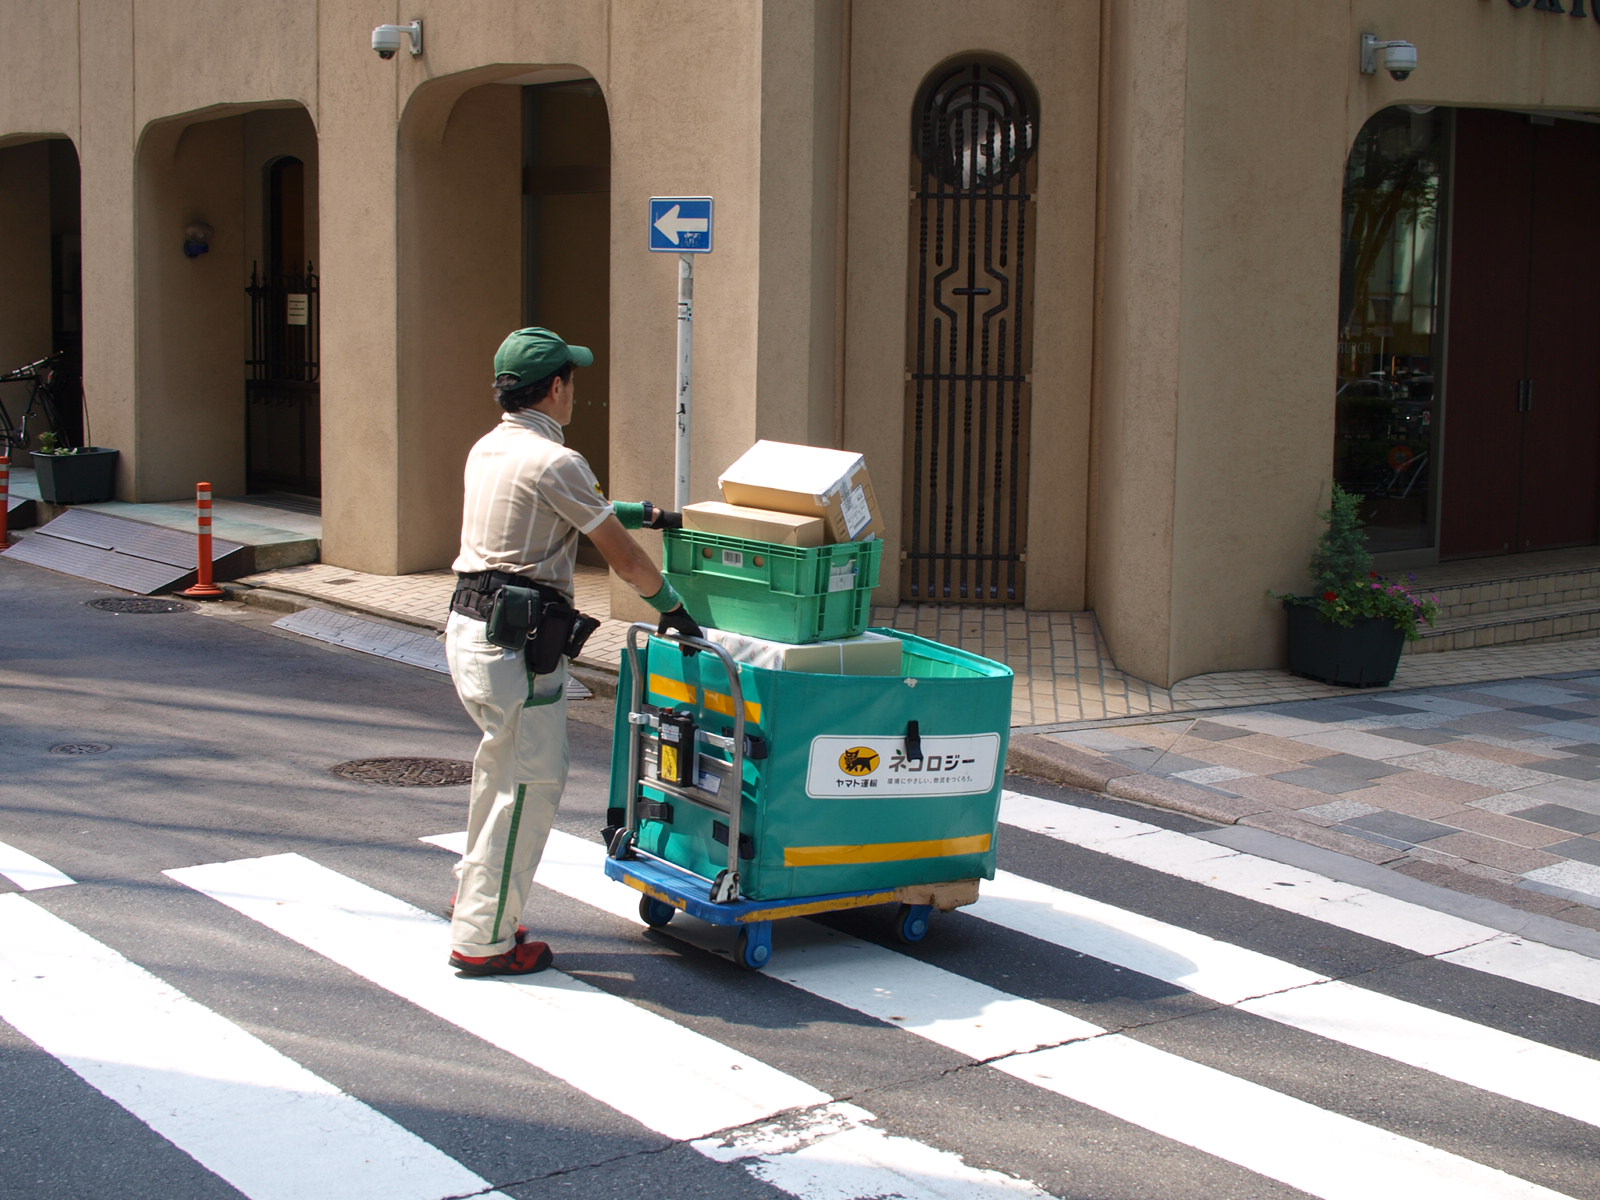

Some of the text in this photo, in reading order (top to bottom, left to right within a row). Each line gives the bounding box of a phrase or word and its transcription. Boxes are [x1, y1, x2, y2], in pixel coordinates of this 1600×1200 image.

[889, 749, 975, 772] ネコロジー
[836, 778, 878, 788] ヤマト運輸
